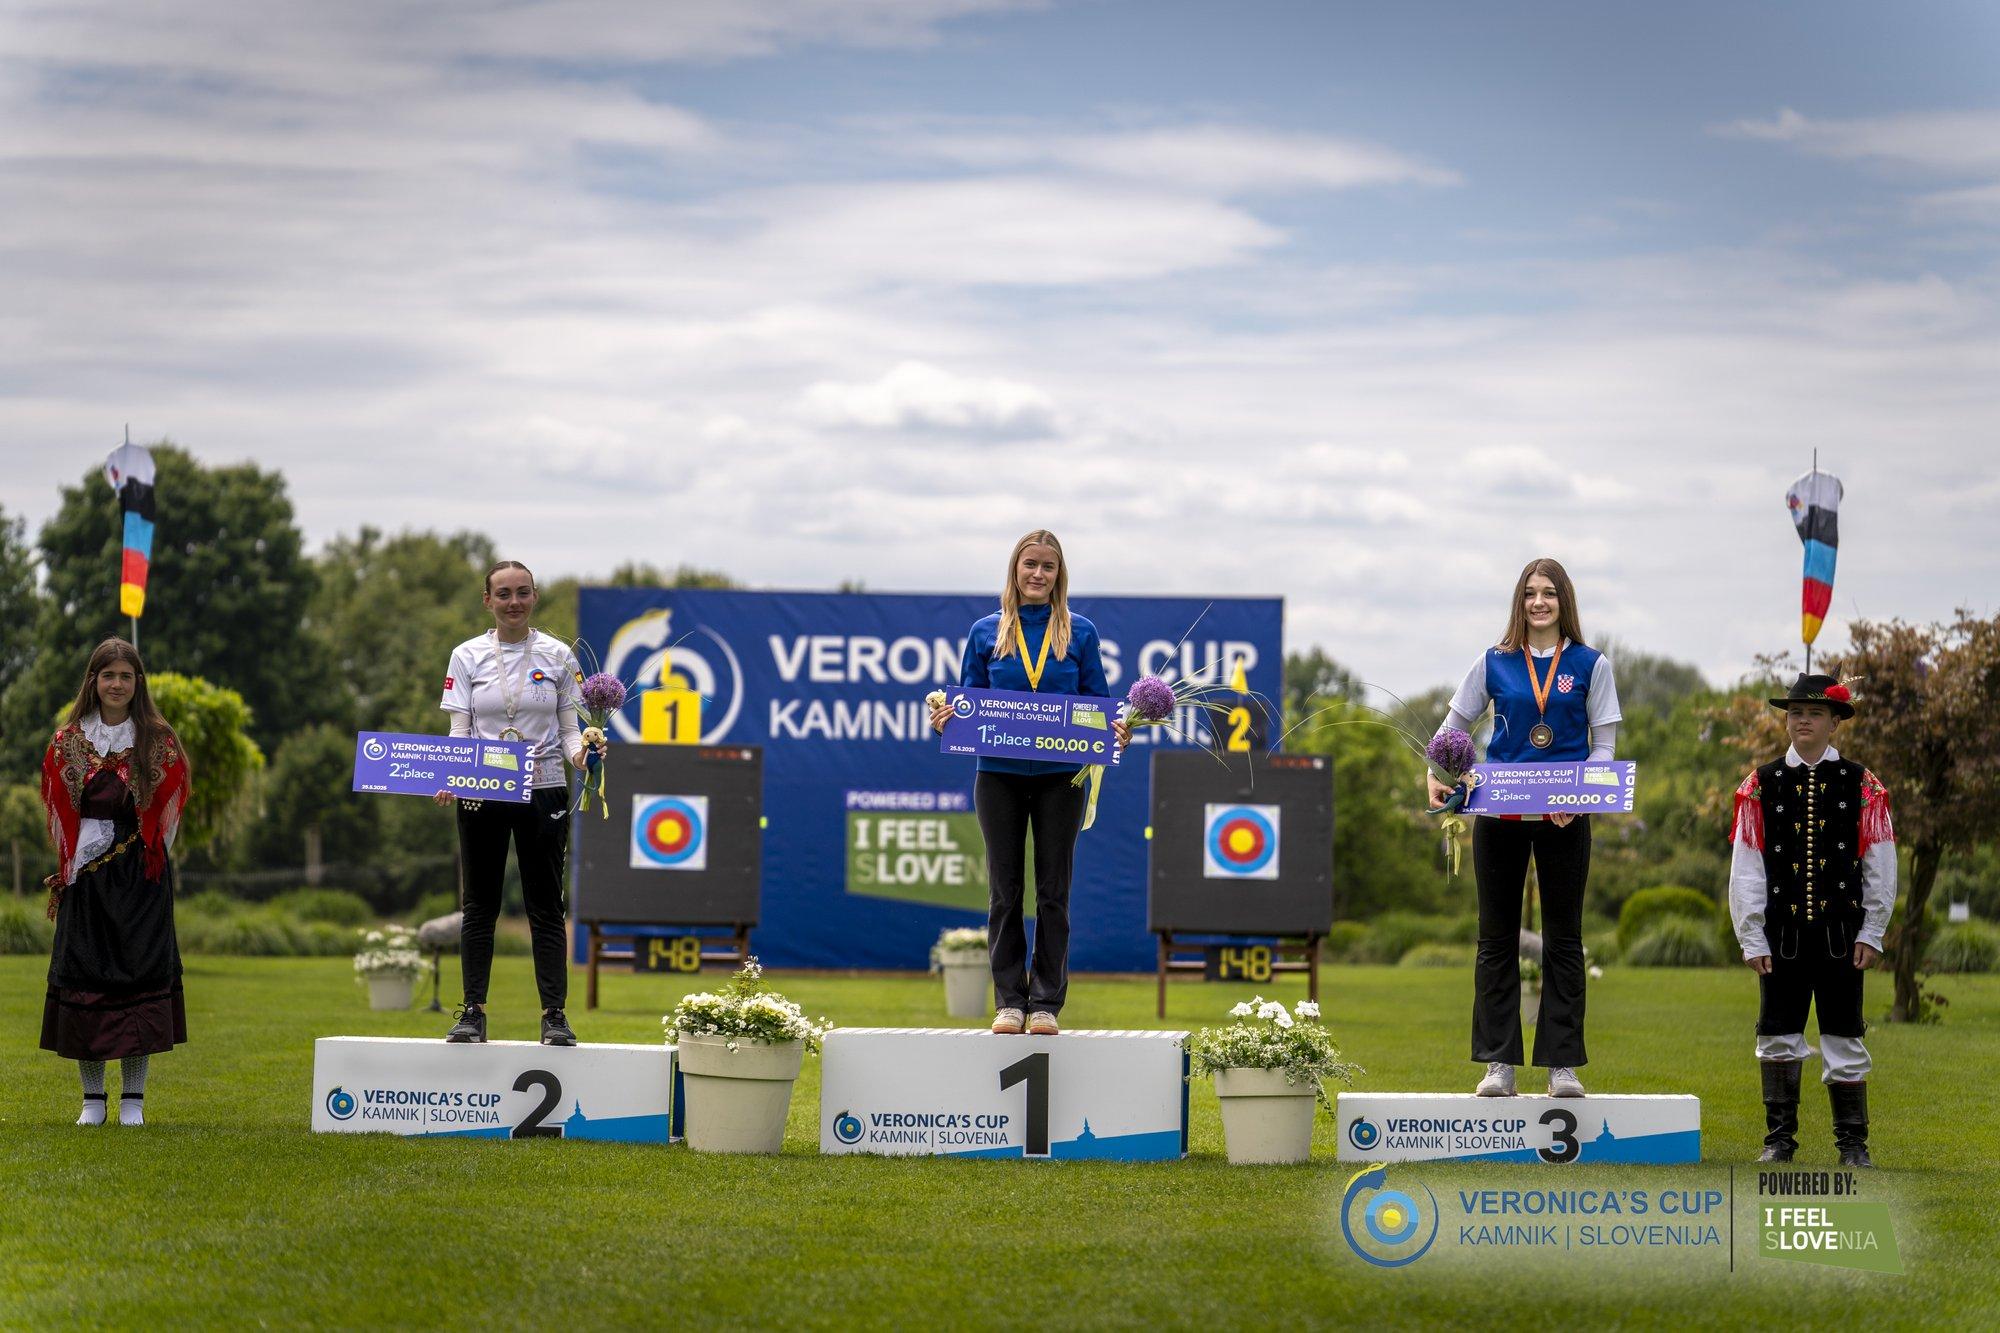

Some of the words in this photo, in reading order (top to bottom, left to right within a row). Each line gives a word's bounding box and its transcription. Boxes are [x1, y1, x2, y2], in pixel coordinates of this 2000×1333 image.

[768, 634, 1122, 685] VERONS
[1138, 639, 1259, 687] CUP
[979, 699, 1039, 711] VERONICA'S
[1041, 703, 1062, 713] CUP
[1072, 702, 1091, 711] POWERED
[664, 700, 678, 740] 1
[768, 699, 931, 740] KAMNI
[979, 709, 1011, 719] KAMNIK
[1016, 712, 1060, 723] SLOVENIJA
[1227, 706, 1251, 752] 2
[391, 742, 450, 753] VERONICA'S
[453, 746, 474, 755] CUP
[1034, 736, 1088, 753] 500,00
[1092, 741, 1105, 754] €
[390, 752, 422, 761] KAMNIK
[427, 754, 472, 764] SLOVENIJA
[1491, 769, 1551, 778] VERONICA'S
[1553, 769, 1574, 777] CUP
[446, 775, 500, 791] 300,00
[503, 780, 517, 791] €
[846, 791, 935, 809] POWERED
[1547, 794, 1601, 806] 200,00
[1604, 794, 1618, 804] €
[854, 818, 871, 849] I
[877, 818, 958, 850] FEEL
[855, 853, 989, 885] SLOVEN
[649, 936, 700, 972] 148
[1219, 945, 1271, 981] 148
[363, 1089, 463, 1107] VERONICA'S
[467, 1093, 501, 1108] CUP
[512, 1069, 563, 1139] 2
[999, 1052, 1050, 1155] 1
[362, 1107, 420, 1121] KAMNIK
[430, 1108, 500, 1124] SLOVENIA
[870, 1112, 971, 1128] VERONICA'S
[975, 1114, 1009, 1129] CUP
[1386, 1118, 1489, 1133] VERONICA'S
[1492, 1119, 1527, 1133] CUP
[869, 1130, 928, 1144] KAMNIK
[938, 1131, 1009, 1145] SLOVENIA
[1386, 1136, 1444, 1149] KAMNIK
[1455, 1136, 1526, 1150] SLOVENIA
[1537, 1108, 1580, 1164] 3
